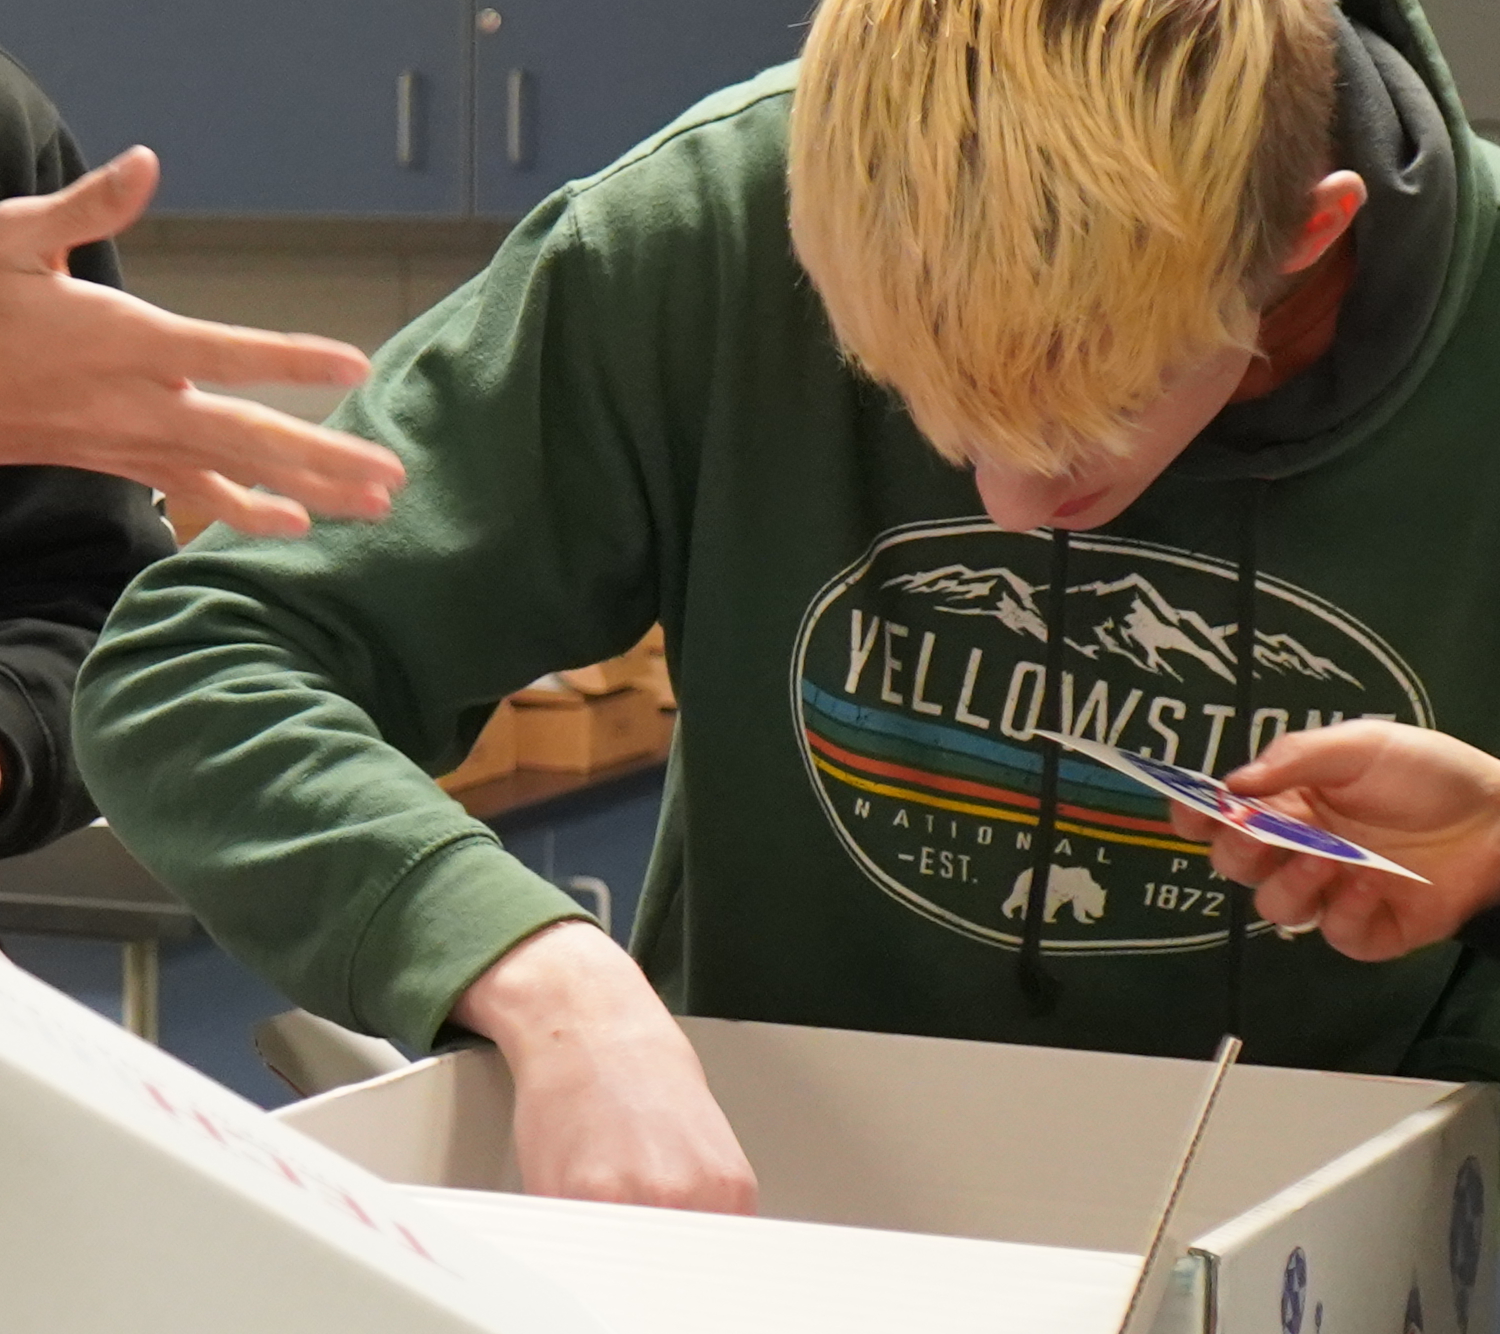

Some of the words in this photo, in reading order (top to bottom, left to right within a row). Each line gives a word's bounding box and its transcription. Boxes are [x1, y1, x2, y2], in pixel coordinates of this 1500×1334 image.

[844, 609, 1396, 776] YELLOWSTO
[853, 797, 1112, 866] NATIONAL
[1142, 882, 1225, 917] 1872
